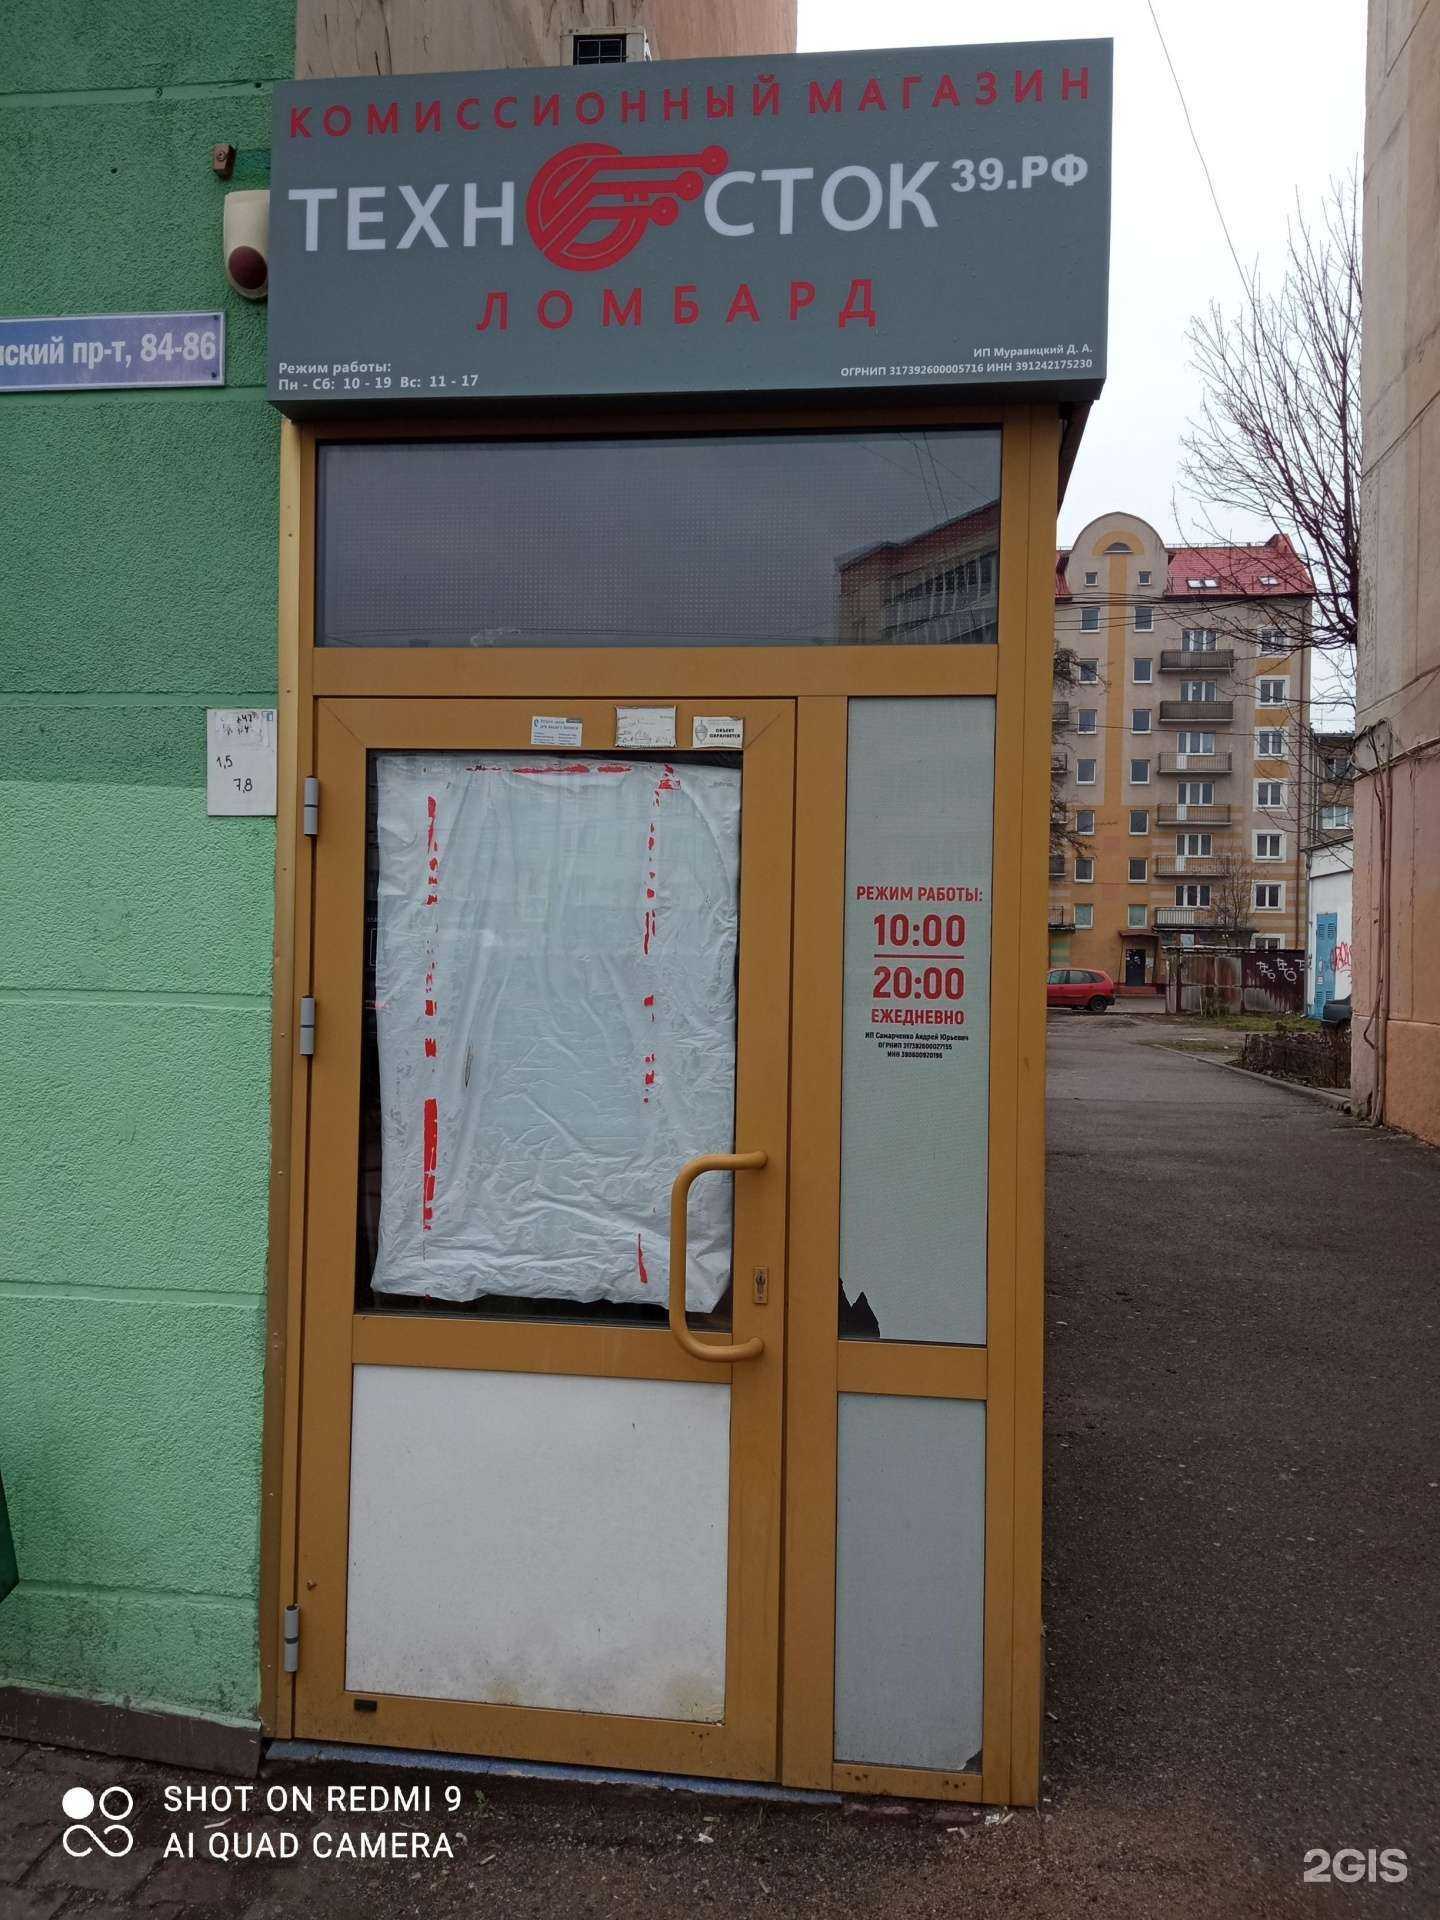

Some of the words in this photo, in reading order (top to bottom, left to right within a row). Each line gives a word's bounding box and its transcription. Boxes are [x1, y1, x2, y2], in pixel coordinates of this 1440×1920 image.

[289, 73, 782, 138] КОМИССИОННЫЙ
[806, 66, 1090, 114] МАГАЗИН
[950, 153, 1089, 193] 39.РФ
[475, 278, 878, 331] ЛОМБАРД
[72, 340, 132, 369] пр-т,
[140, 331, 216, 363] 84-86
[973, 347, 991, 358] ИП
[994, 344, 1064, 359] Муравицкий
[1081, 343, 1093, 354] А.
[278, 362, 328, 374] Режим
[333, 361, 392, 377] работы:
[840, 366, 887, 377] ОГРНИП
[889, 363, 984, 376] 317392600005716
[986, 362, 1013, 373] ИНН
[1015, 359, 1093, 372] 391242175230
[278, 379, 298, 391] Пн
[312, 378, 336, 390] Сб:
[343, 378, 361, 389] 10
[375, 376, 392, 389] 19
[400, 376, 421, 388] Вс:
[429, 375, 447, 387] 11
[461, 374, 479, 387] 17
[856, 886, 913, 901] РЕЖИМ
[917, 887, 983, 902] РАБОТЫ:
[873, 913, 966, 947] 10:00
[872, 966, 965, 1000] 20:00
[871, 1008, 965, 1026] ЕЖЕДНЕВНО
